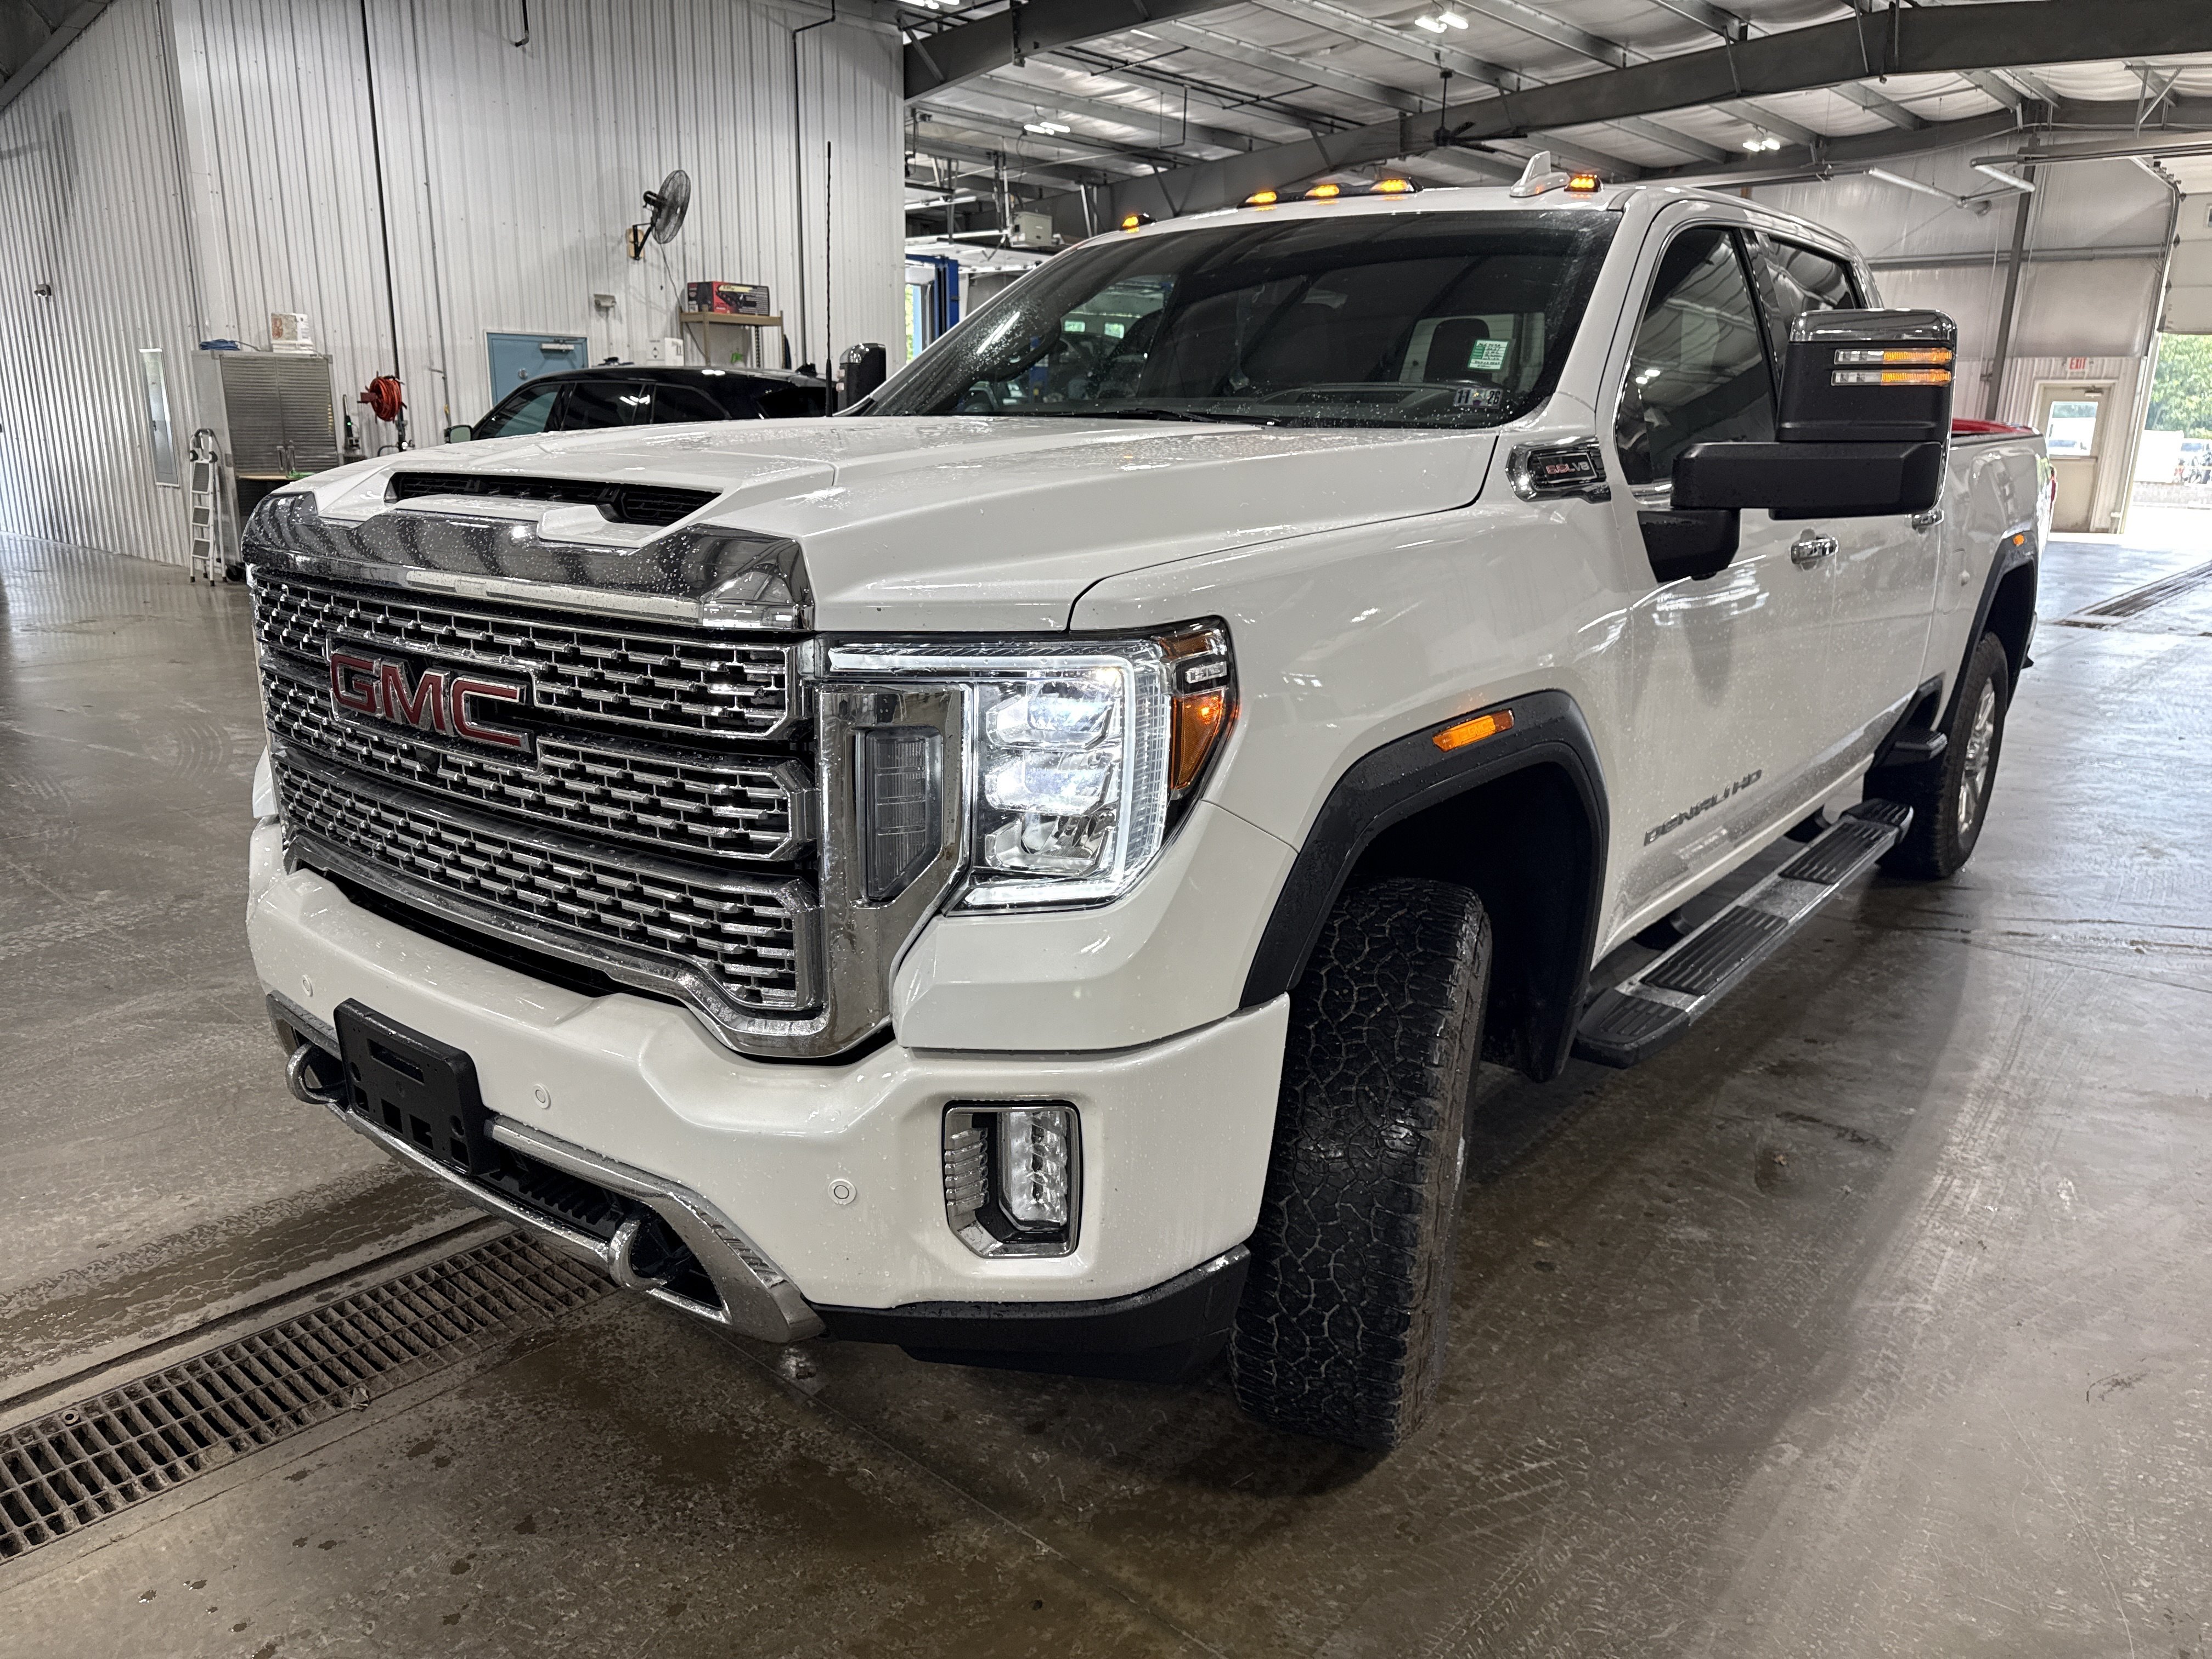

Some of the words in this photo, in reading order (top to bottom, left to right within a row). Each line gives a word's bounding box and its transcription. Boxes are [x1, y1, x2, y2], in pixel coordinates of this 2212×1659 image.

[2069, 357, 2087, 369] EXIT
[1487, 390, 1501, 405] 26
[330, 647, 532, 752] GMC
[1644, 785, 1730, 847] DENALI
[1731, 769, 1763, 795] HD
